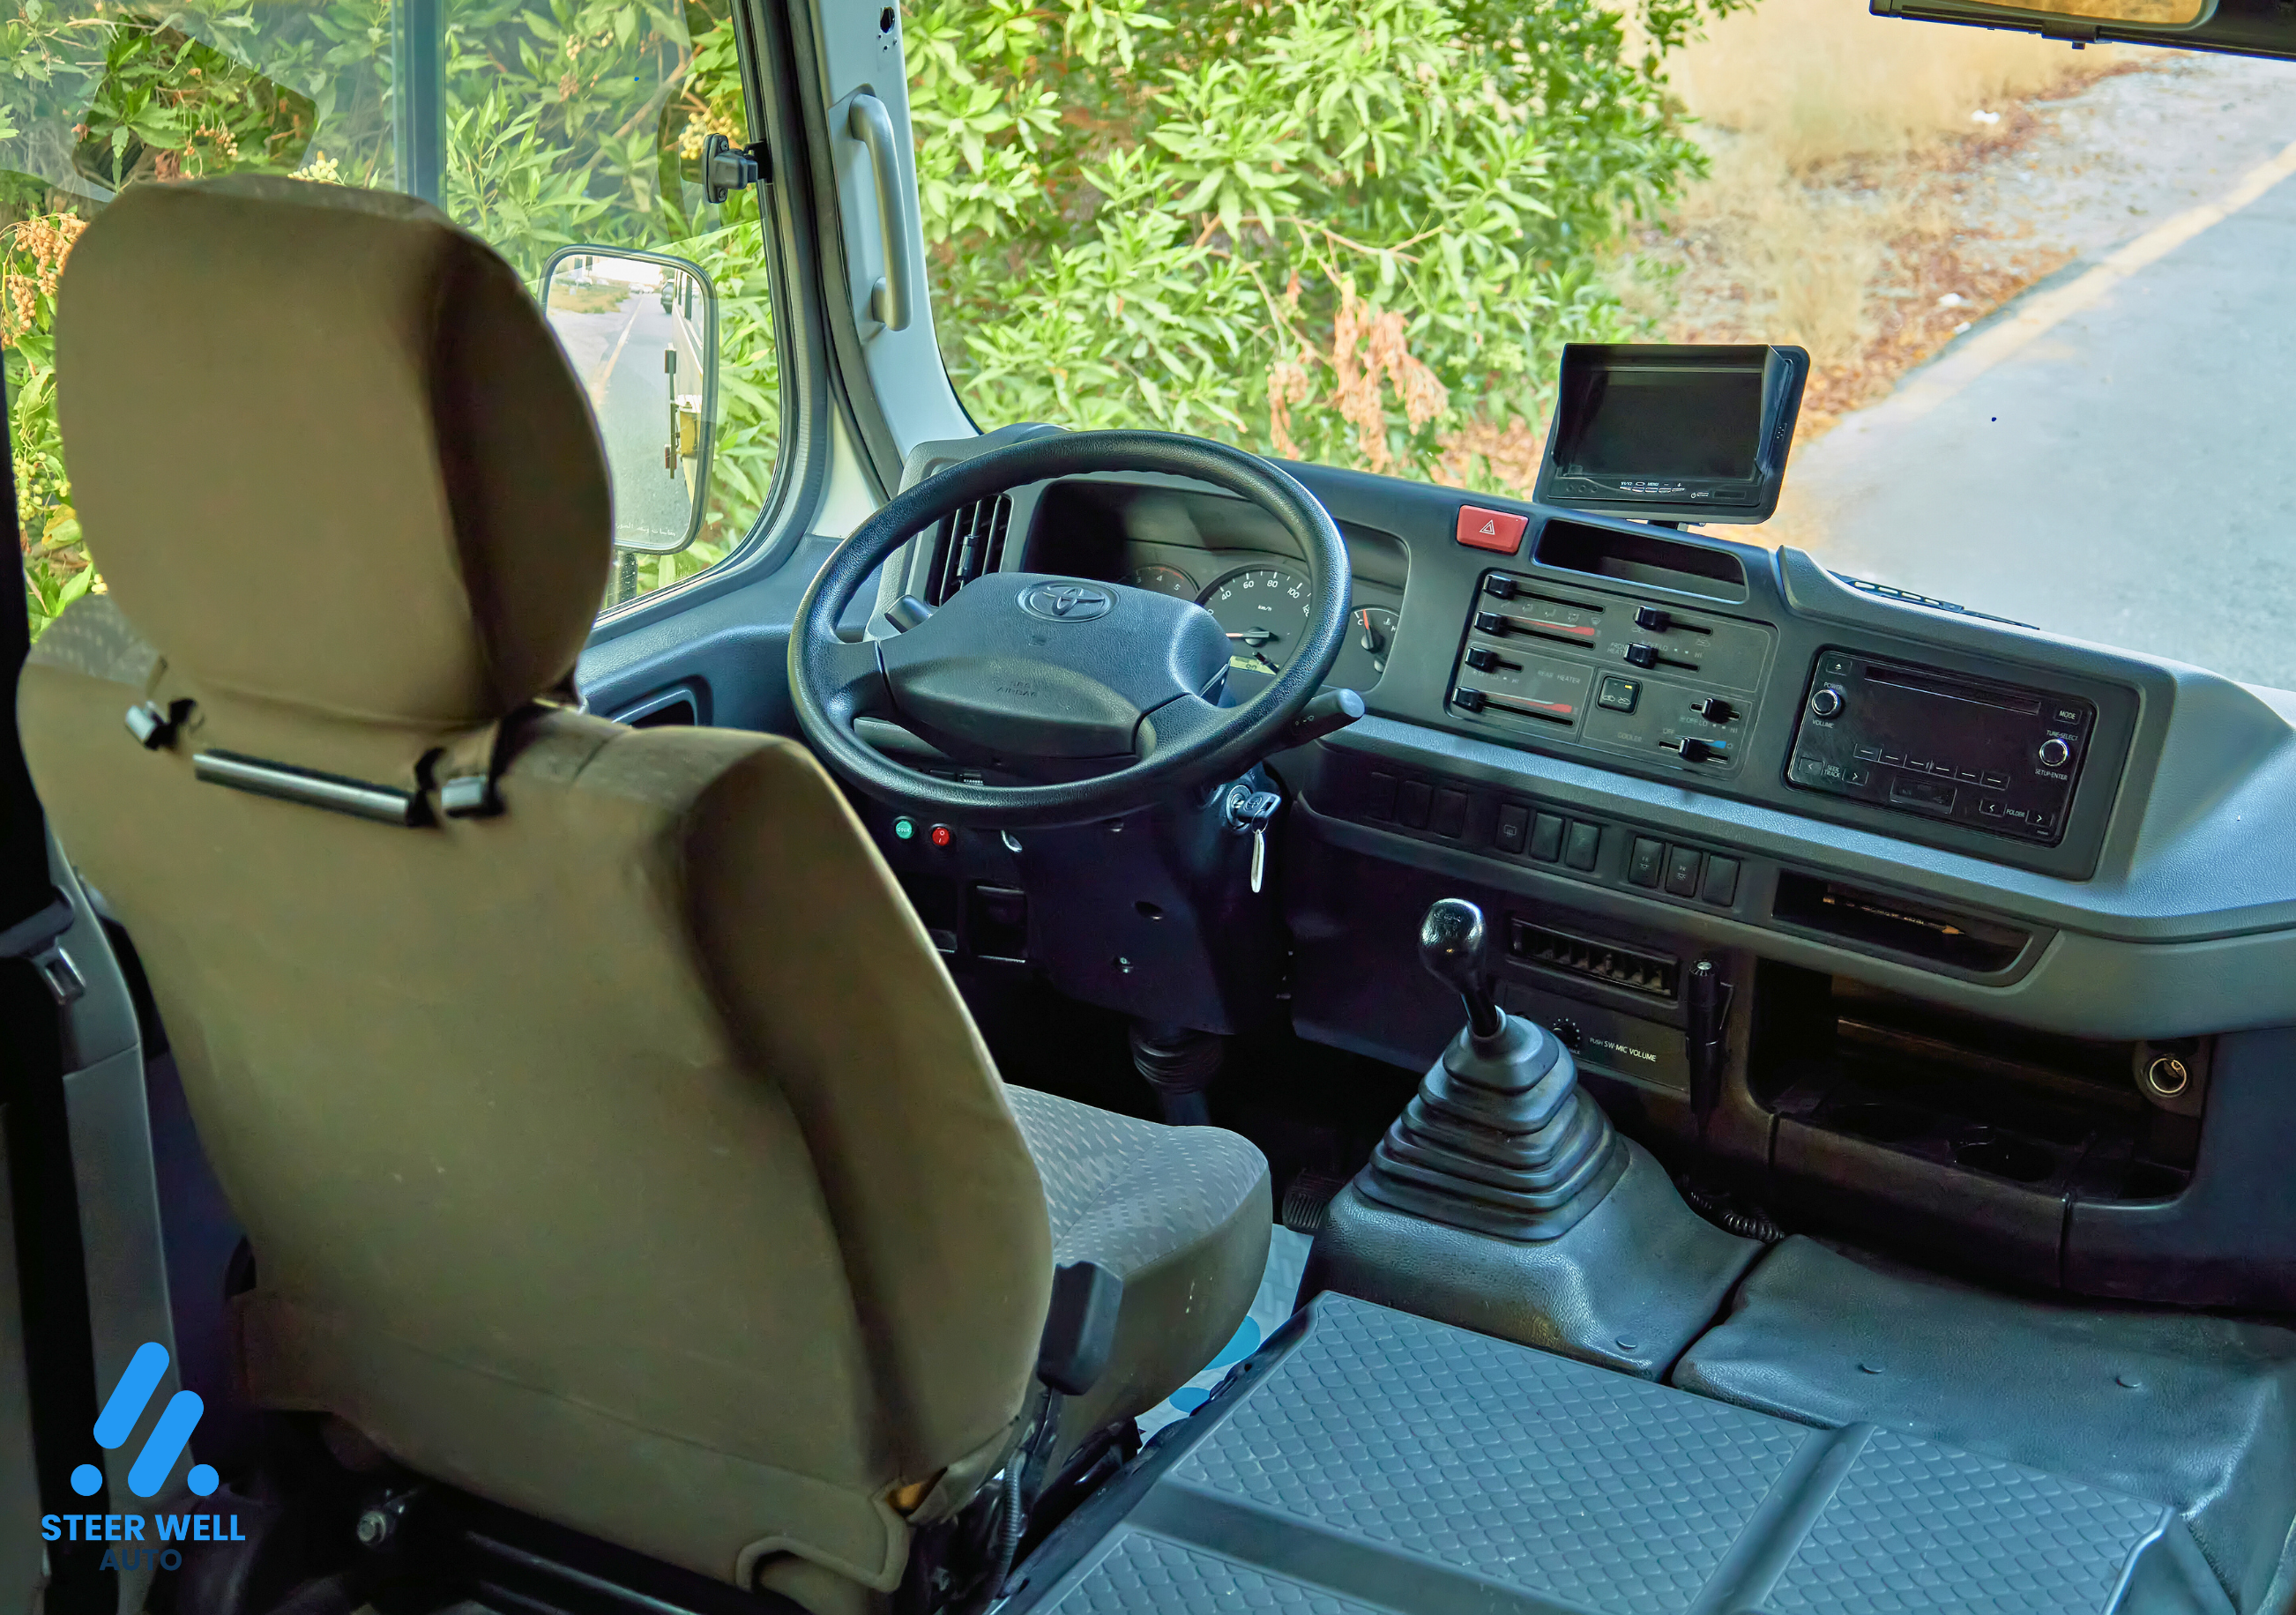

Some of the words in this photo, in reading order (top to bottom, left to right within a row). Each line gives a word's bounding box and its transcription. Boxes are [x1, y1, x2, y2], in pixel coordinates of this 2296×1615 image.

[1242, 580, 1255, 589] 60
[1266, 579, 1278, 588] 80
[1221, 590, 1232, 600] 40
[1287, 587, 1300, 599] 100
[1556, 674, 1581, 684] HEATER
[1823, 681, 1844, 690] POWER
[2059, 710, 2076, 720] MODE
[1812, 719, 1834, 729] VOLUME
[1617, 732, 1643, 742] COOLER
[1824, 769, 1841, 778] TRACK
[1827, 764, 1840, 773] SEEK
[2006, 808, 2025, 818] FOLDER
[1589, 1037, 1604, 1046] PUSH
[1629, 1047, 1657, 1062] VOLUME
